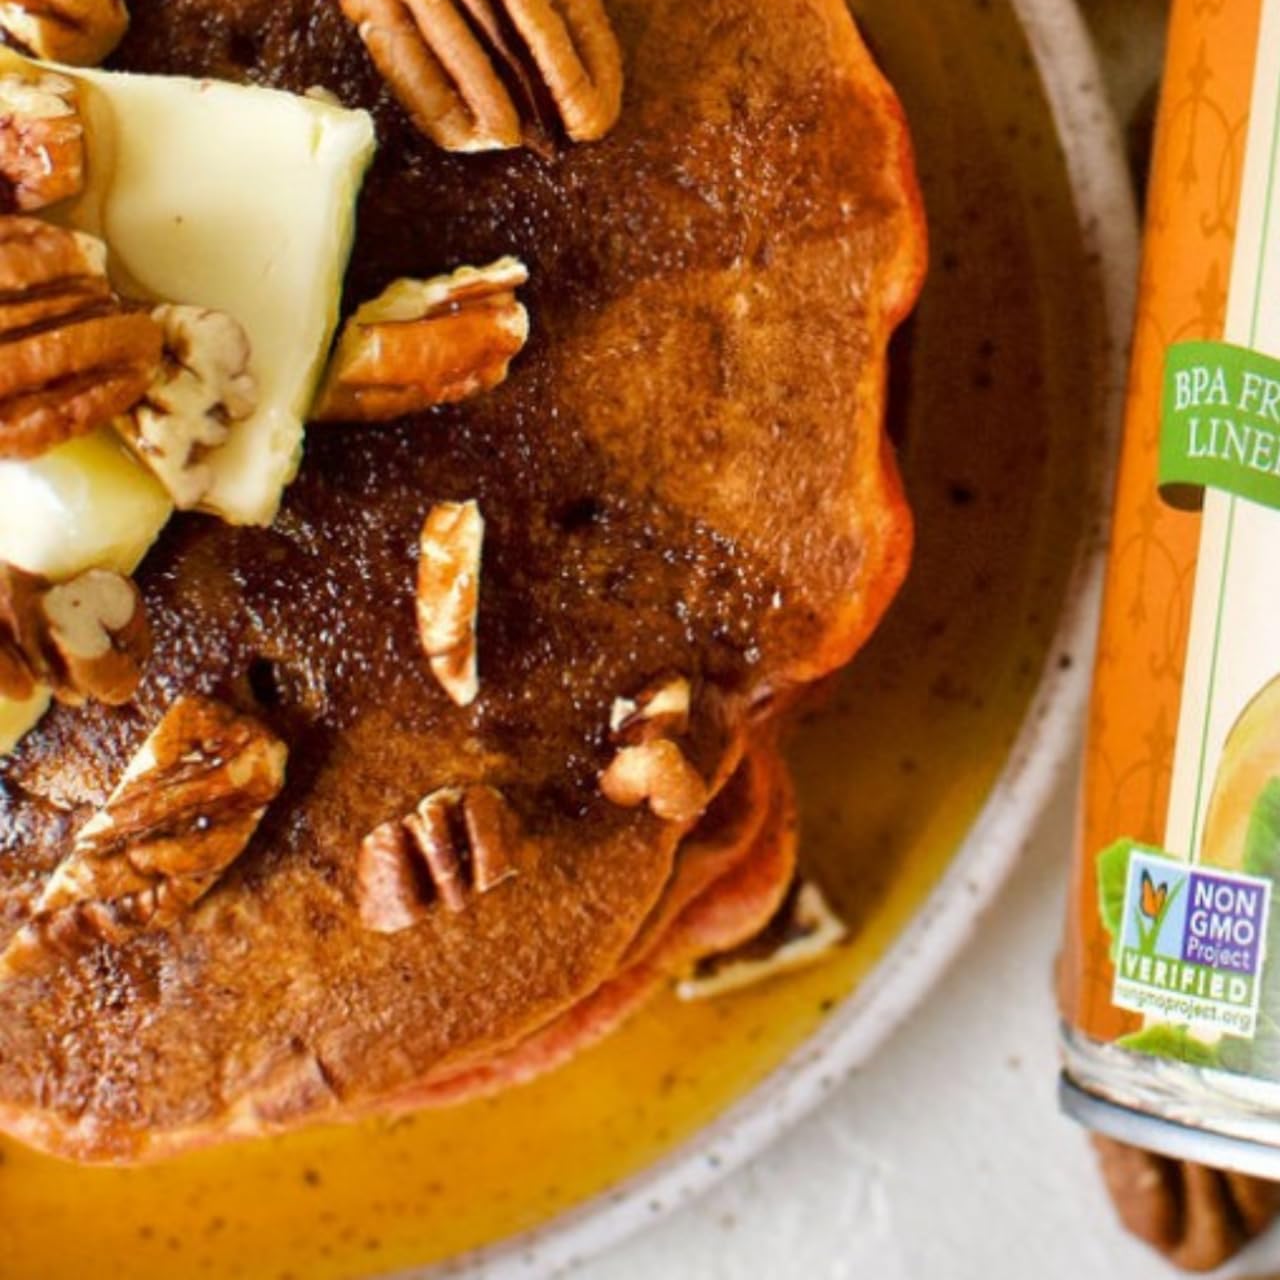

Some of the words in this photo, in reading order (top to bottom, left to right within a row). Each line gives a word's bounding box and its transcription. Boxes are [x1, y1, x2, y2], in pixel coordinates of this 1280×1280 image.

[1174, 364, 1231, 412] BPA
[1194, 880, 1257, 917] NON
[1189, 910, 1255, 946] GMO
[1187, 936, 1251, 969] Project
[1125, 951, 1248, 1003] VERIFIED
